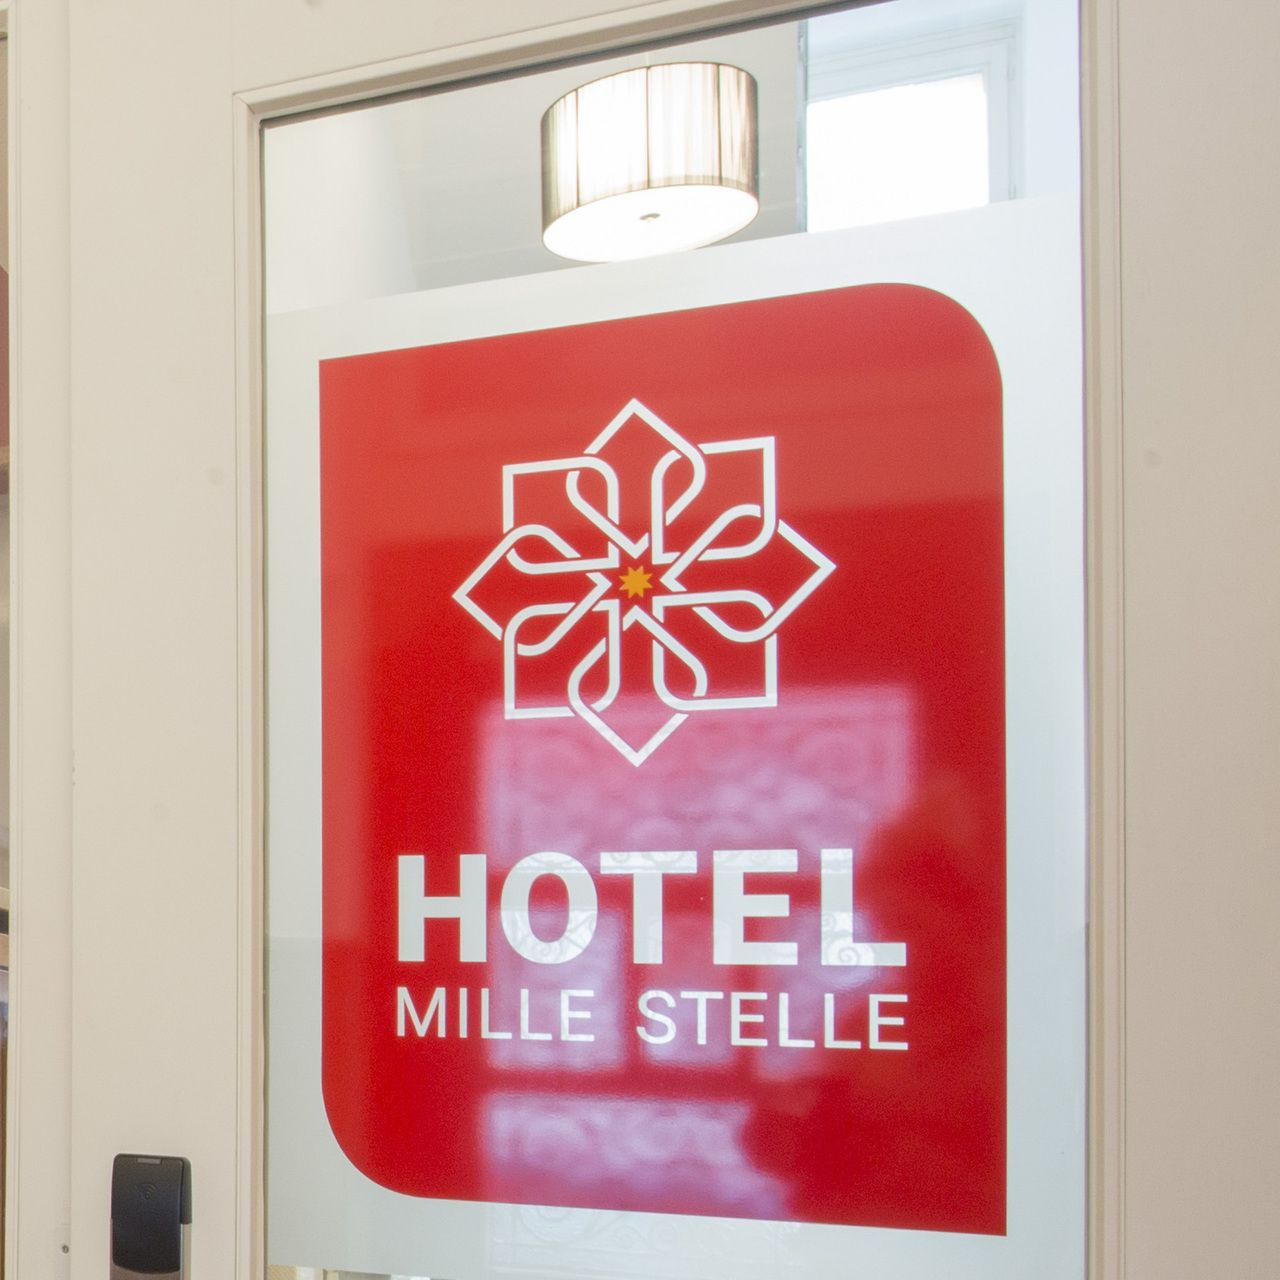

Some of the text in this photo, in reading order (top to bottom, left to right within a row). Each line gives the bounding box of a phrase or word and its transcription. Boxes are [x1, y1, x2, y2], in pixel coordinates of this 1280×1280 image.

[396, 847, 907, 968] HOTEL
[396, 986, 910, 1051] MILLE STELLE
